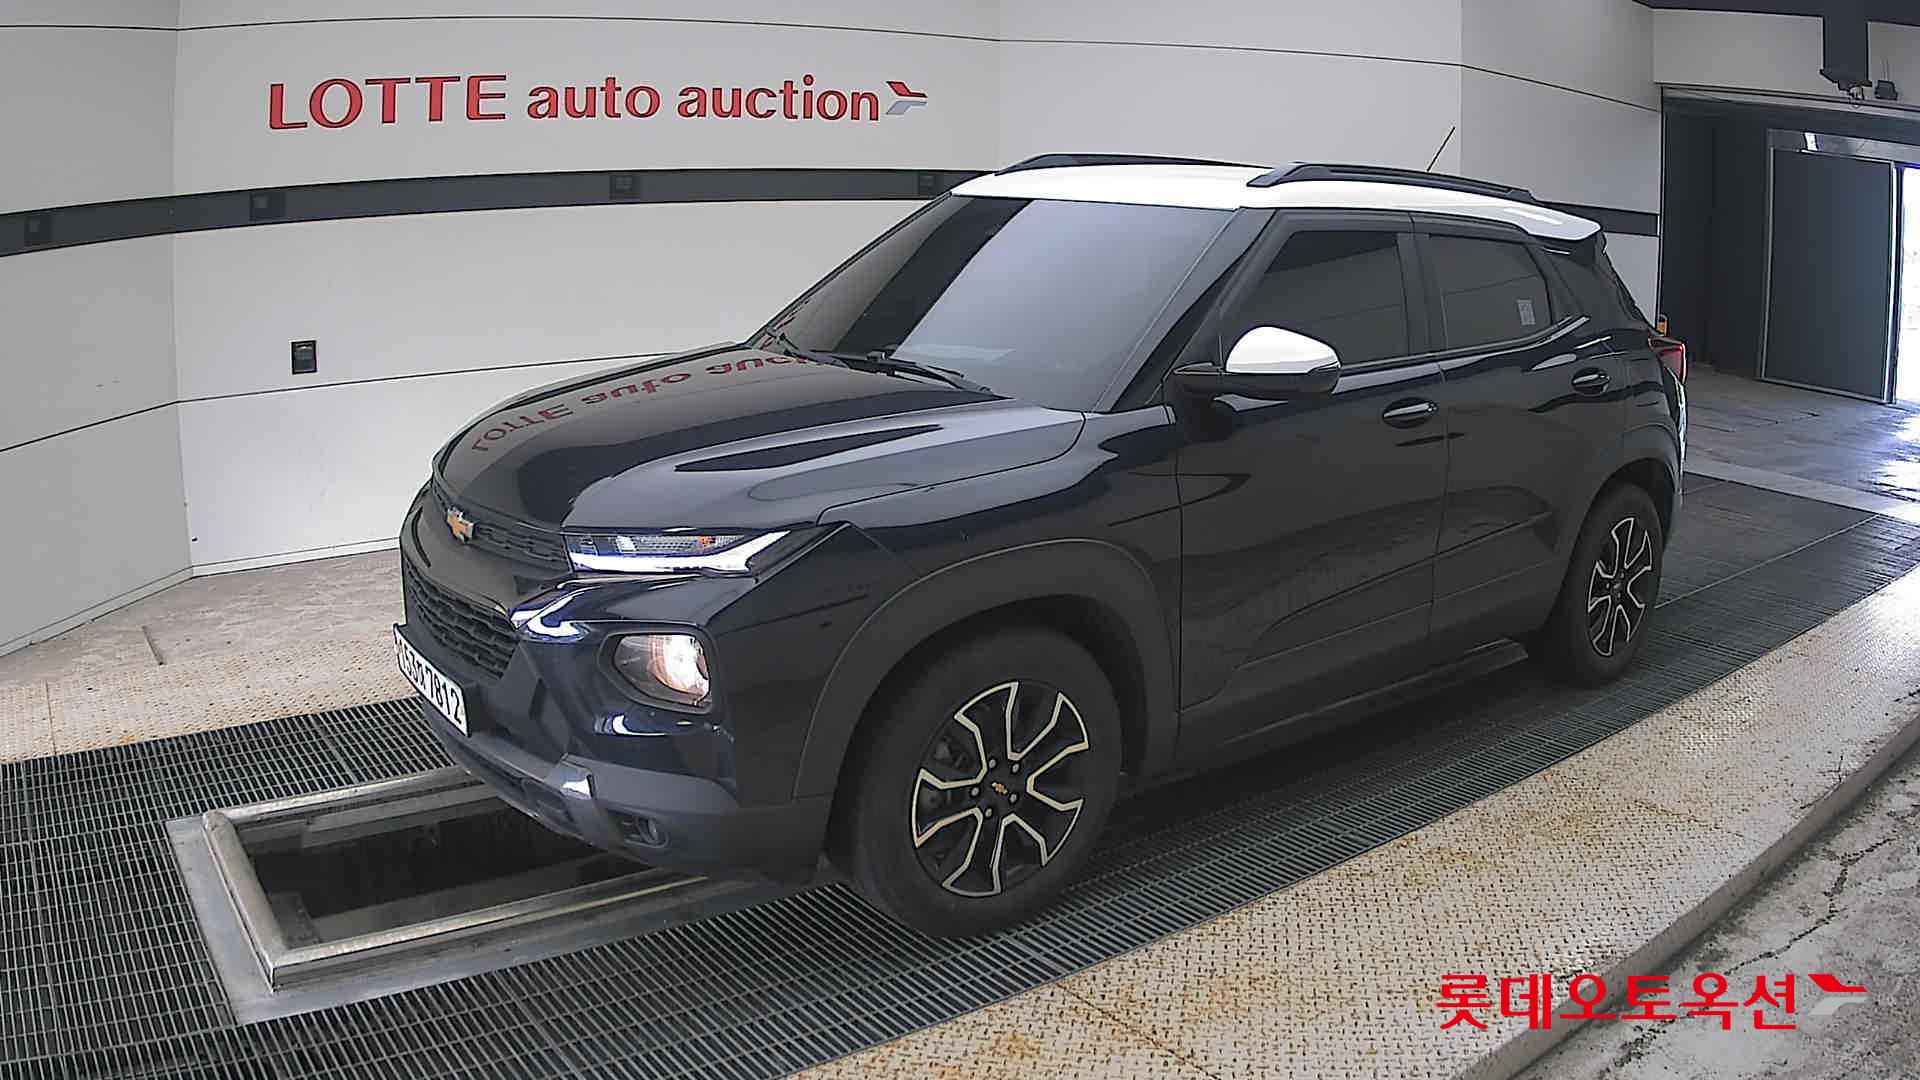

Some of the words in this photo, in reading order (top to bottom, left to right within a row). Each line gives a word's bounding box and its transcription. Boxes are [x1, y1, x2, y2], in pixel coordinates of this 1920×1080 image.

[269, 75, 507, 130] LOTTE
[527, 76, 661, 120] auto
[677, 74, 880, 121] auction
[425, 664, 463, 726] 7812
